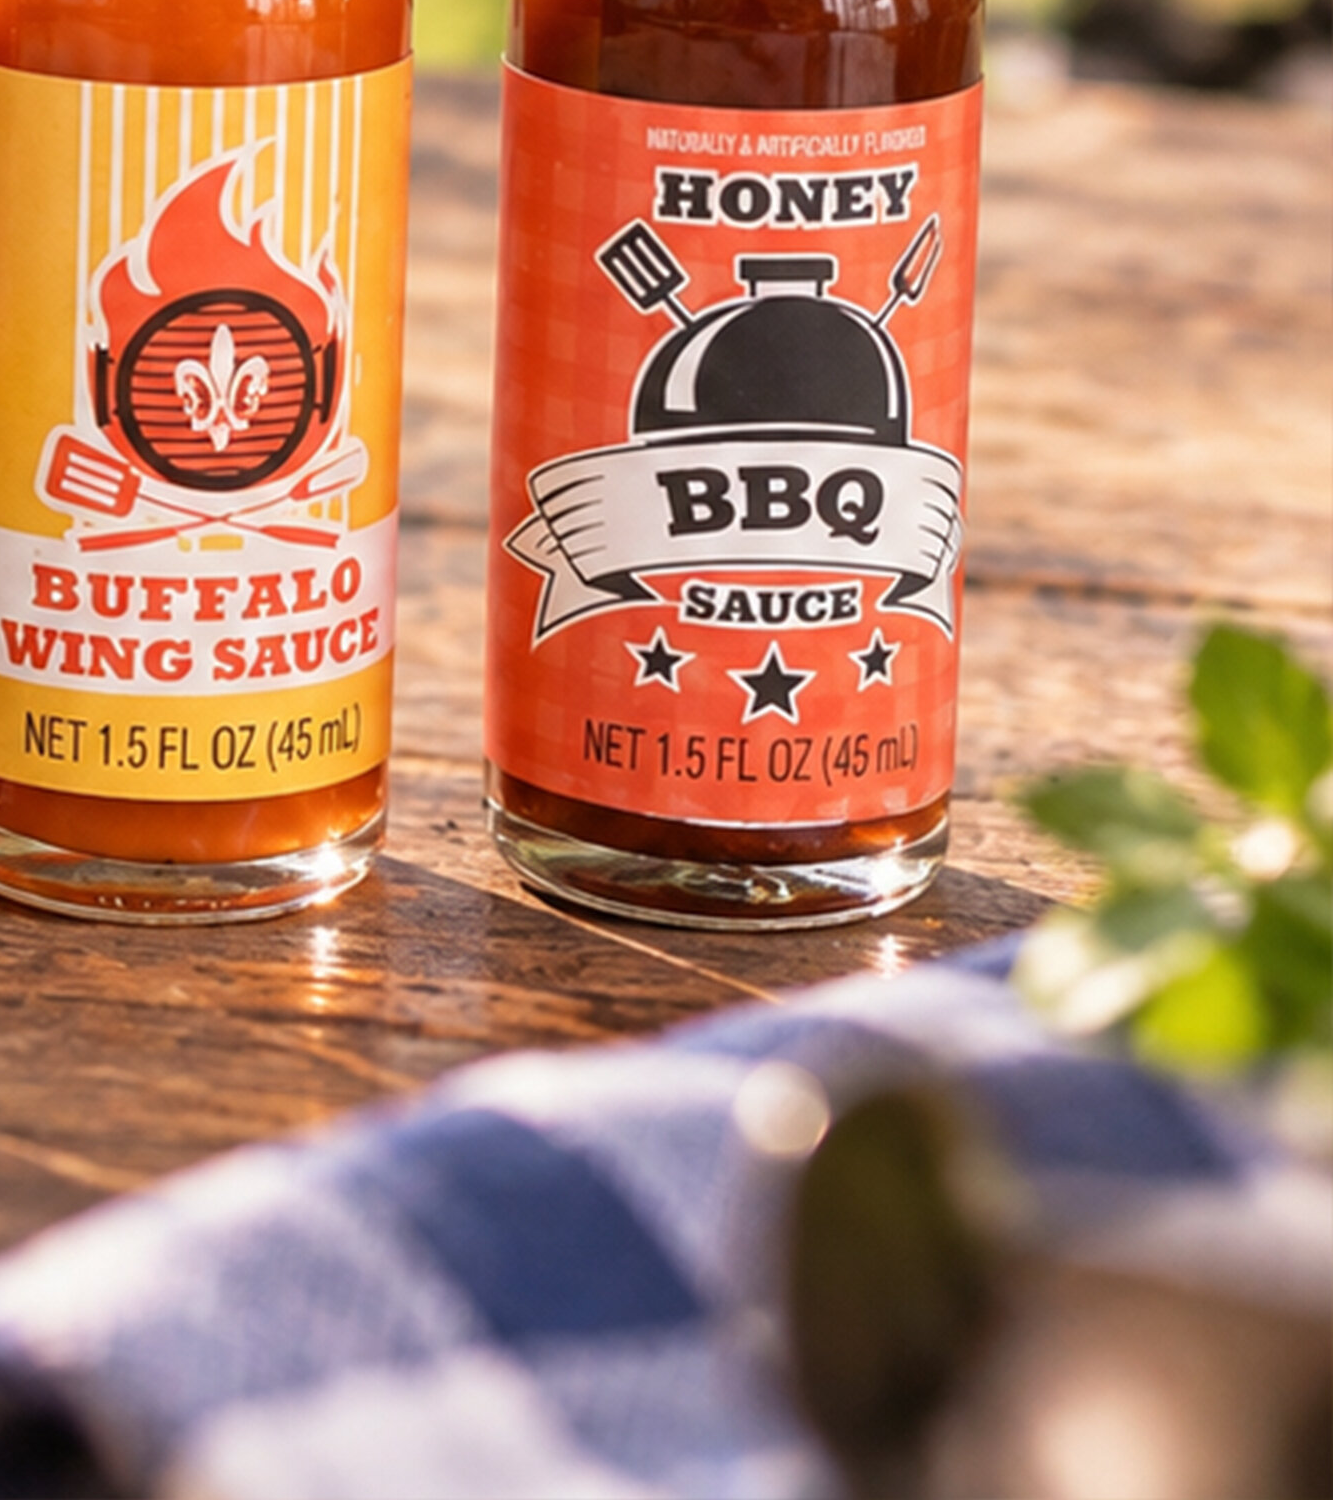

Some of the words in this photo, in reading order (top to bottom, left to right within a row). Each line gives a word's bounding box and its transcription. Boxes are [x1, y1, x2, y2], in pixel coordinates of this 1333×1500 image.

[656, 169, 916, 224] HONEY
[656, 463, 885, 547] BBQ
[31, 556, 363, 622] BUFFALO
[683, 583, 861, 625] SAUCE
[0, 617, 195, 683] WING
[212, 607, 381, 683] SAUCE
[24, 711, 89, 764] NET
[97, 724, 148, 771] 1.5
[158, 726, 201, 771] FL
[211, 724, 257, 771] OZ
[266, 716, 314, 774] (45
[583, 719, 648, 771] NET
[656, 732, 707, 781] 1.5
[715, 737, 759, 784] FL
[767, 737, 814, 783] OZ
